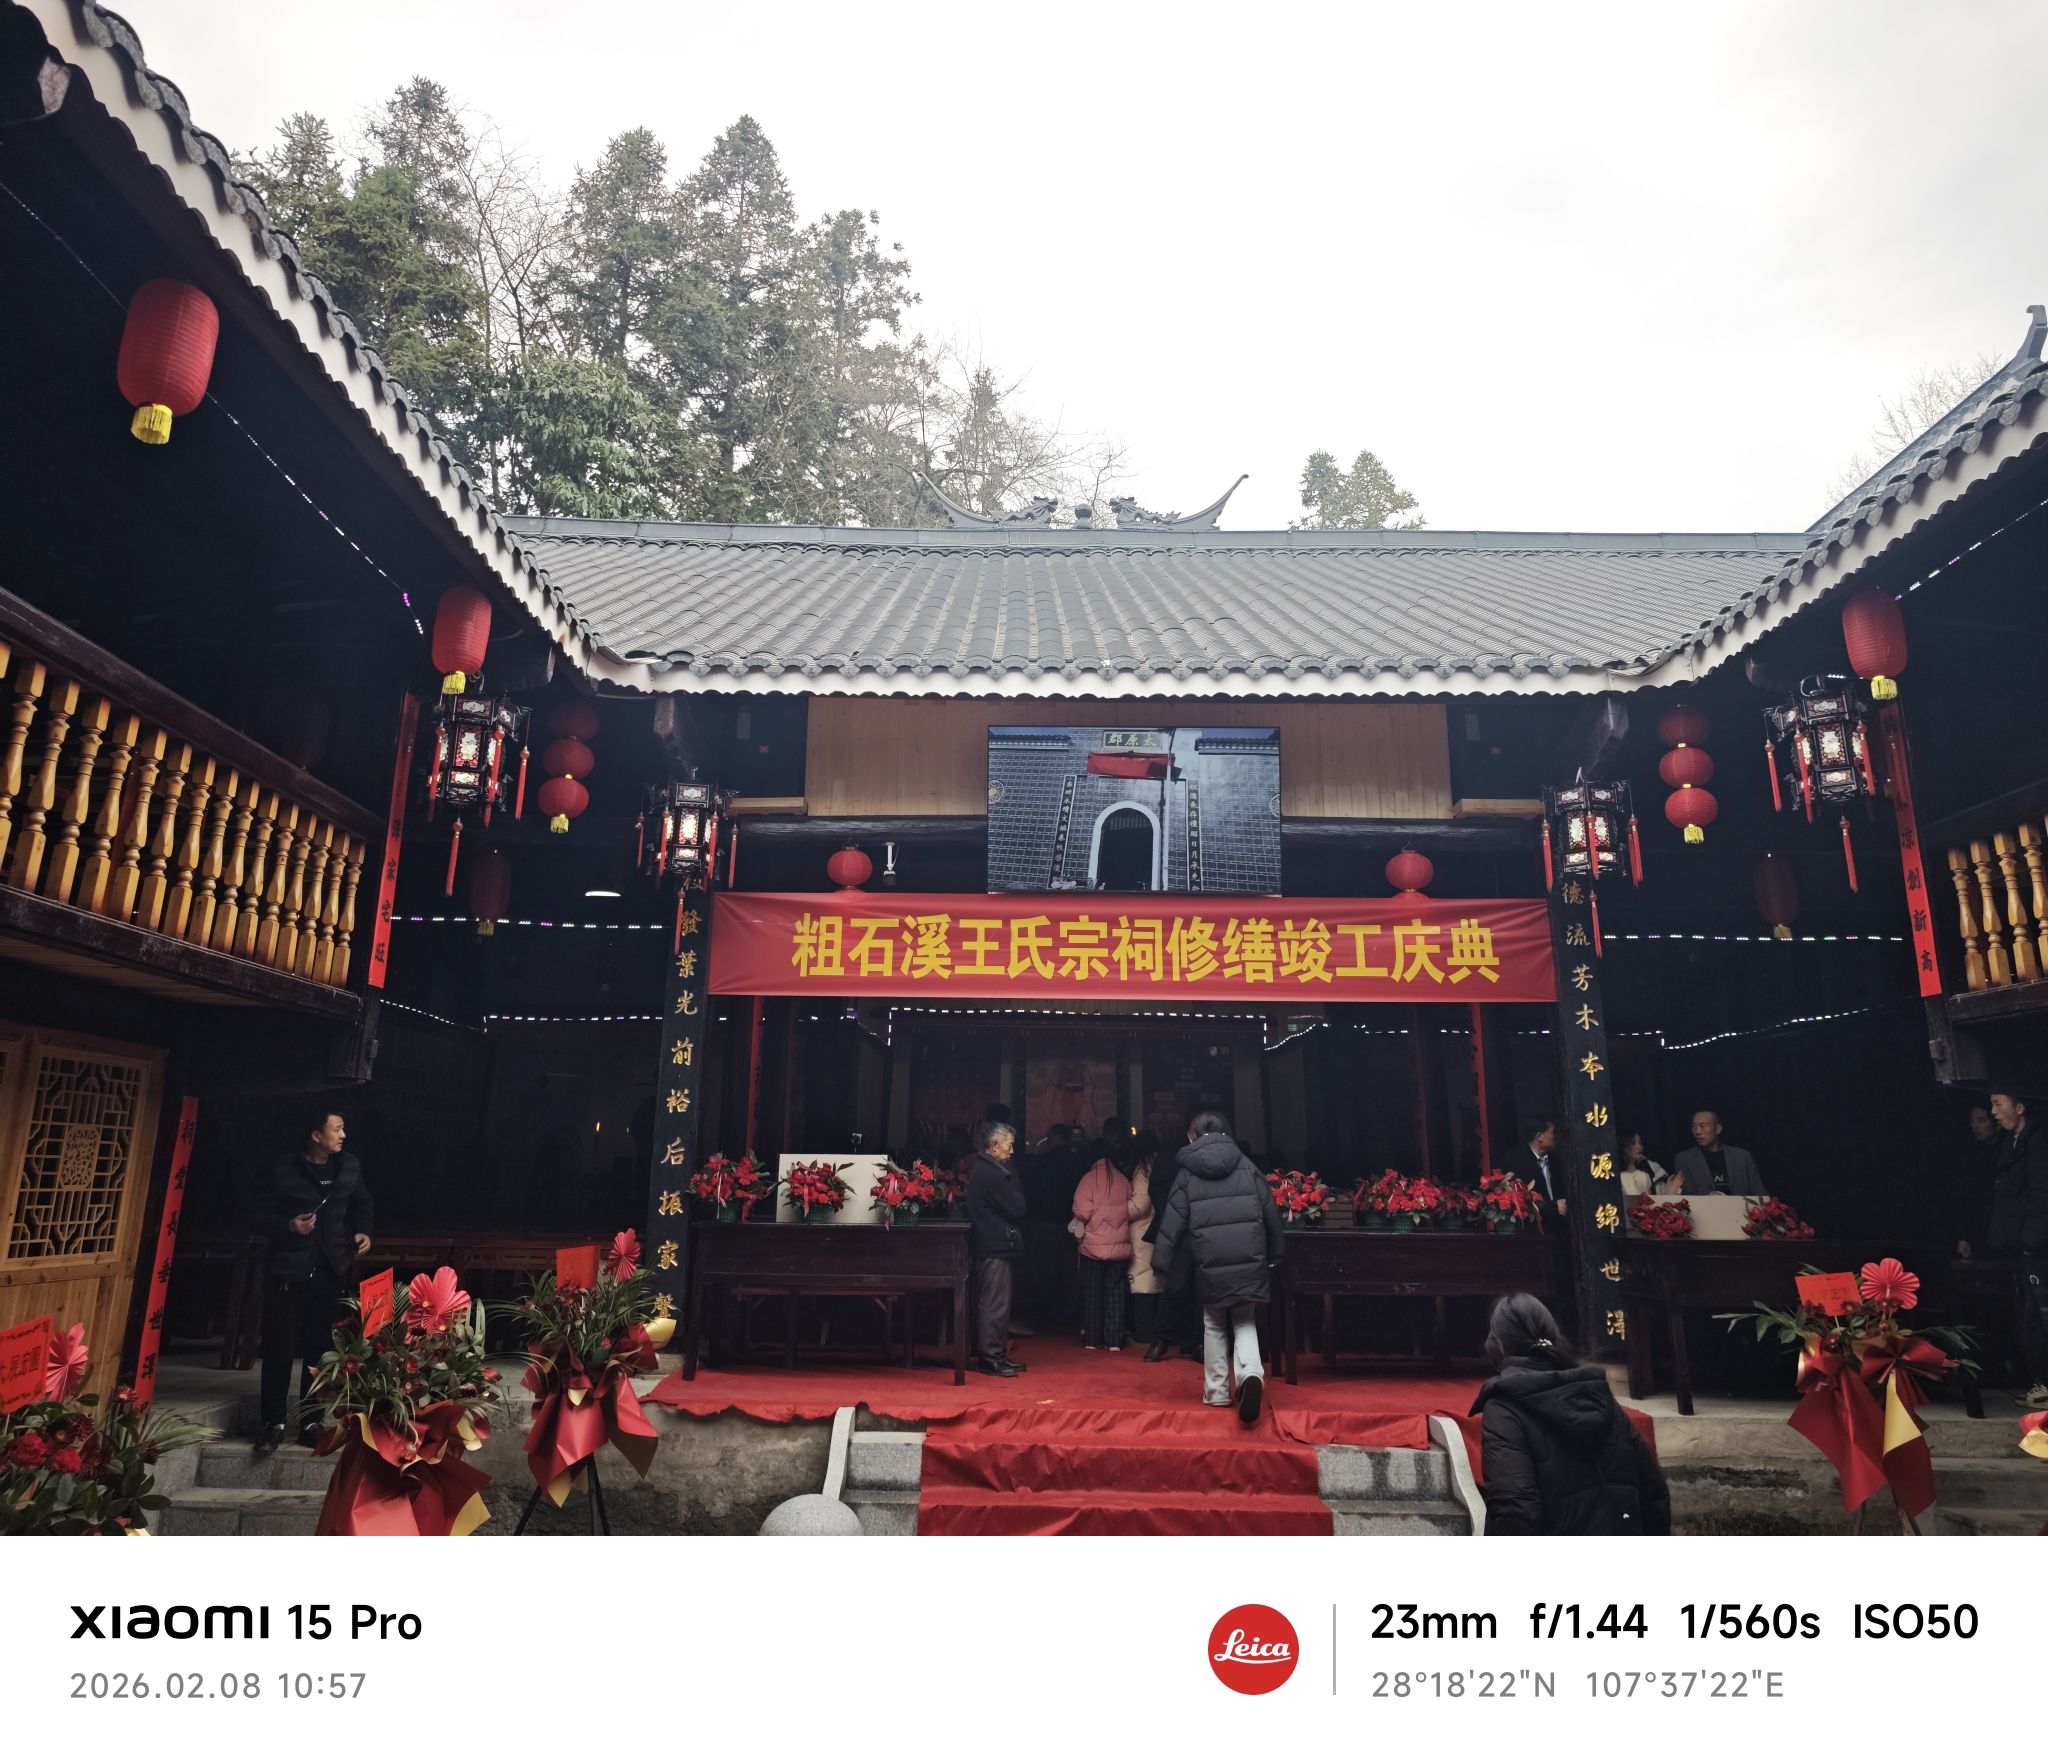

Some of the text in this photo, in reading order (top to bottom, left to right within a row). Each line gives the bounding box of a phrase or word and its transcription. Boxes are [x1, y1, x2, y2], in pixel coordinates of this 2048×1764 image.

[792, 913, 1500, 985] 粗石溪王氏宗祠修缮竣工庆典
